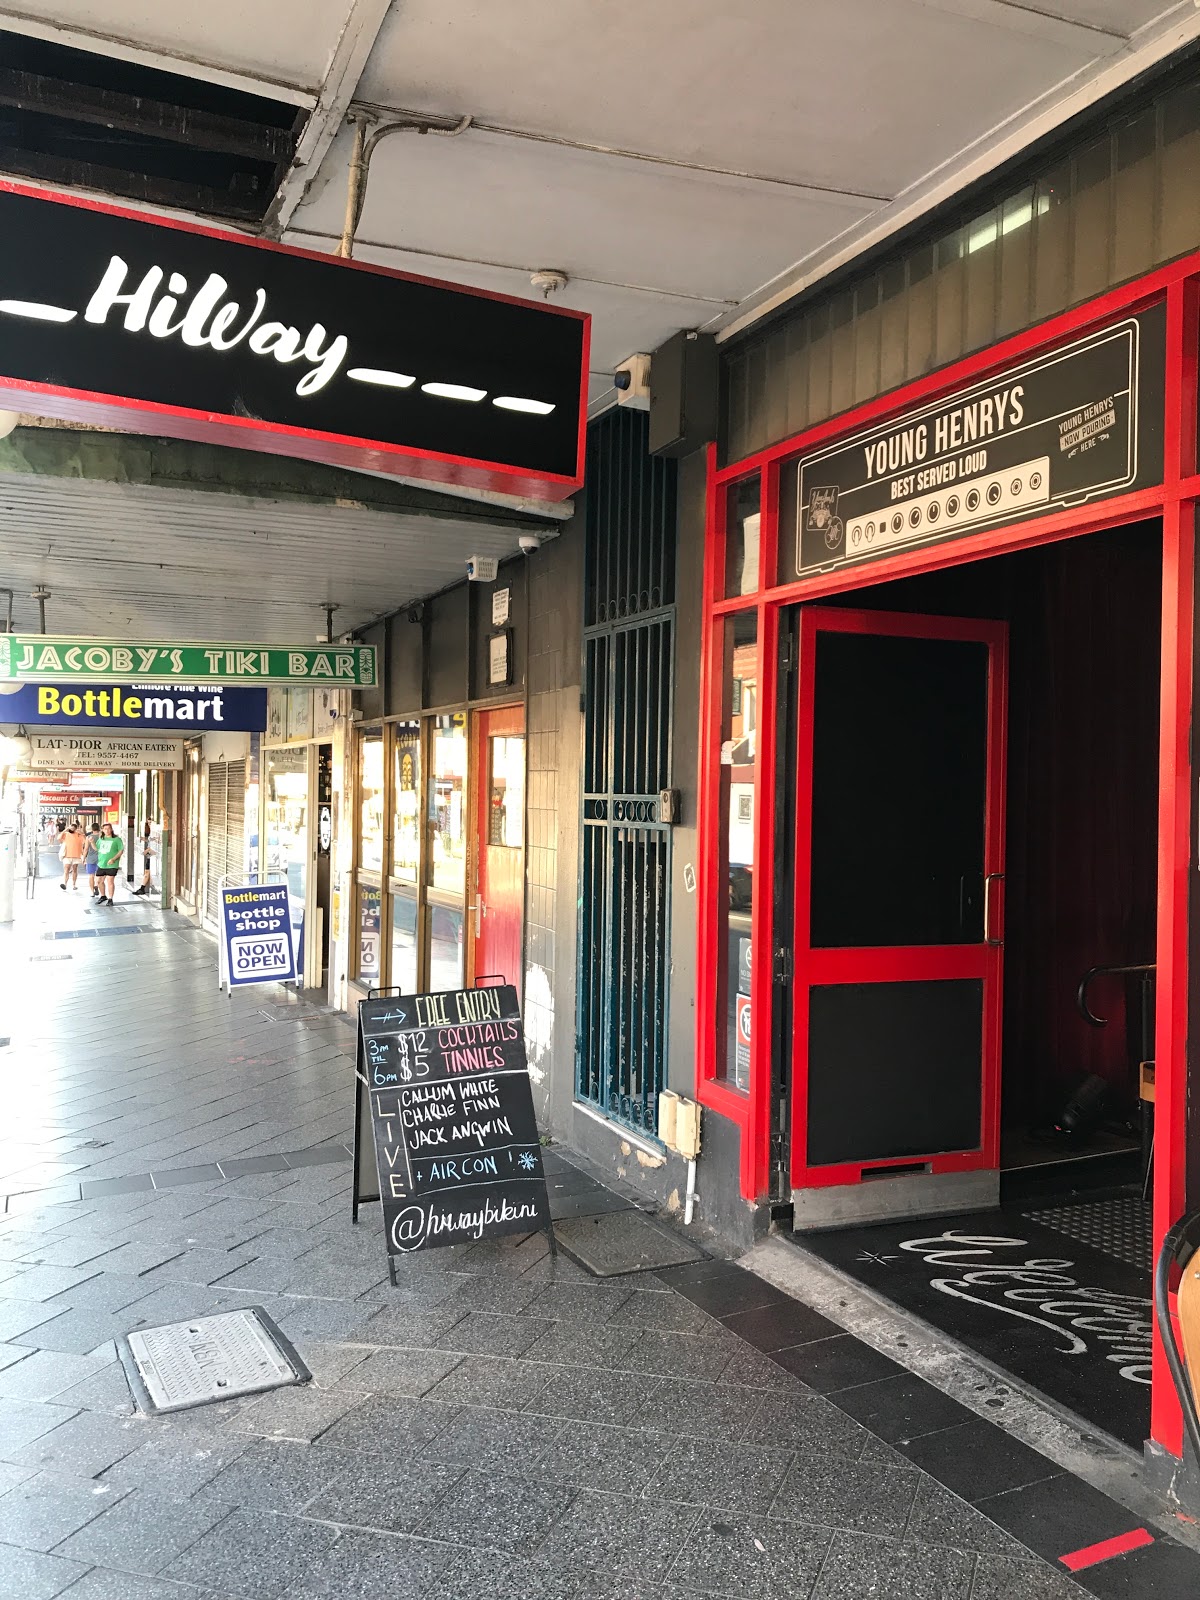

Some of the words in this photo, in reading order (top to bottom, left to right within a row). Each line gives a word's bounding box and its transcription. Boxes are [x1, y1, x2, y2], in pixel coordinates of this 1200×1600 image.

[1058, 413, 1082, 434] YOUNG
[1083, 396, 1114, 421] HENRYS
[1064, 431, 1080, 447] NOW
[1081, 414, 1111, 437] POURING
[864, 424, 927, 480] YOUNG
[934, 385, 1024, 454] HENRYS
[1080, 437, 1097, 452] HERE
[890, 479, 915, 500] BEST
[916, 459, 956, 491] SERVED
[959, 449, 987, 477] LOUD
[16, 646, 184, 673] JACOBY'S
[204, 650, 270, 675] TIKI
[288, 653, 355, 678] BAR
[37, 686, 224, 721] Bottlemart
[37, 739, 102, 749] LAT-DIOR
[107, 743, 143, 751] AFRICAN
[145, 744, 177, 752] EATERY
[225, 890, 286, 904] Bottlemart
[228, 906, 286, 920] bottle
[235, 919, 281, 931] shop
[237, 954, 286, 969] OPEN
[238, 943, 283, 957] NOW
[415, 994, 451, 1027] FREE
[455, 988, 501, 1024] ENTRY
[398, 1031, 429, 1055] $12
[438, 1020, 518, 1049] COCKTAILS
[441, 1046, 505, 1073] TINNIES
[401, 1083, 456, 1107] CALLUM
[459, 1079, 499, 1101] WHITE
[402, 1103, 456, 1128] CHARLIE
[462, 1095, 500, 1116] FINN
[409, 1126, 448, 1149] JACK
[452, 1116, 513, 1147] ANGWIN
